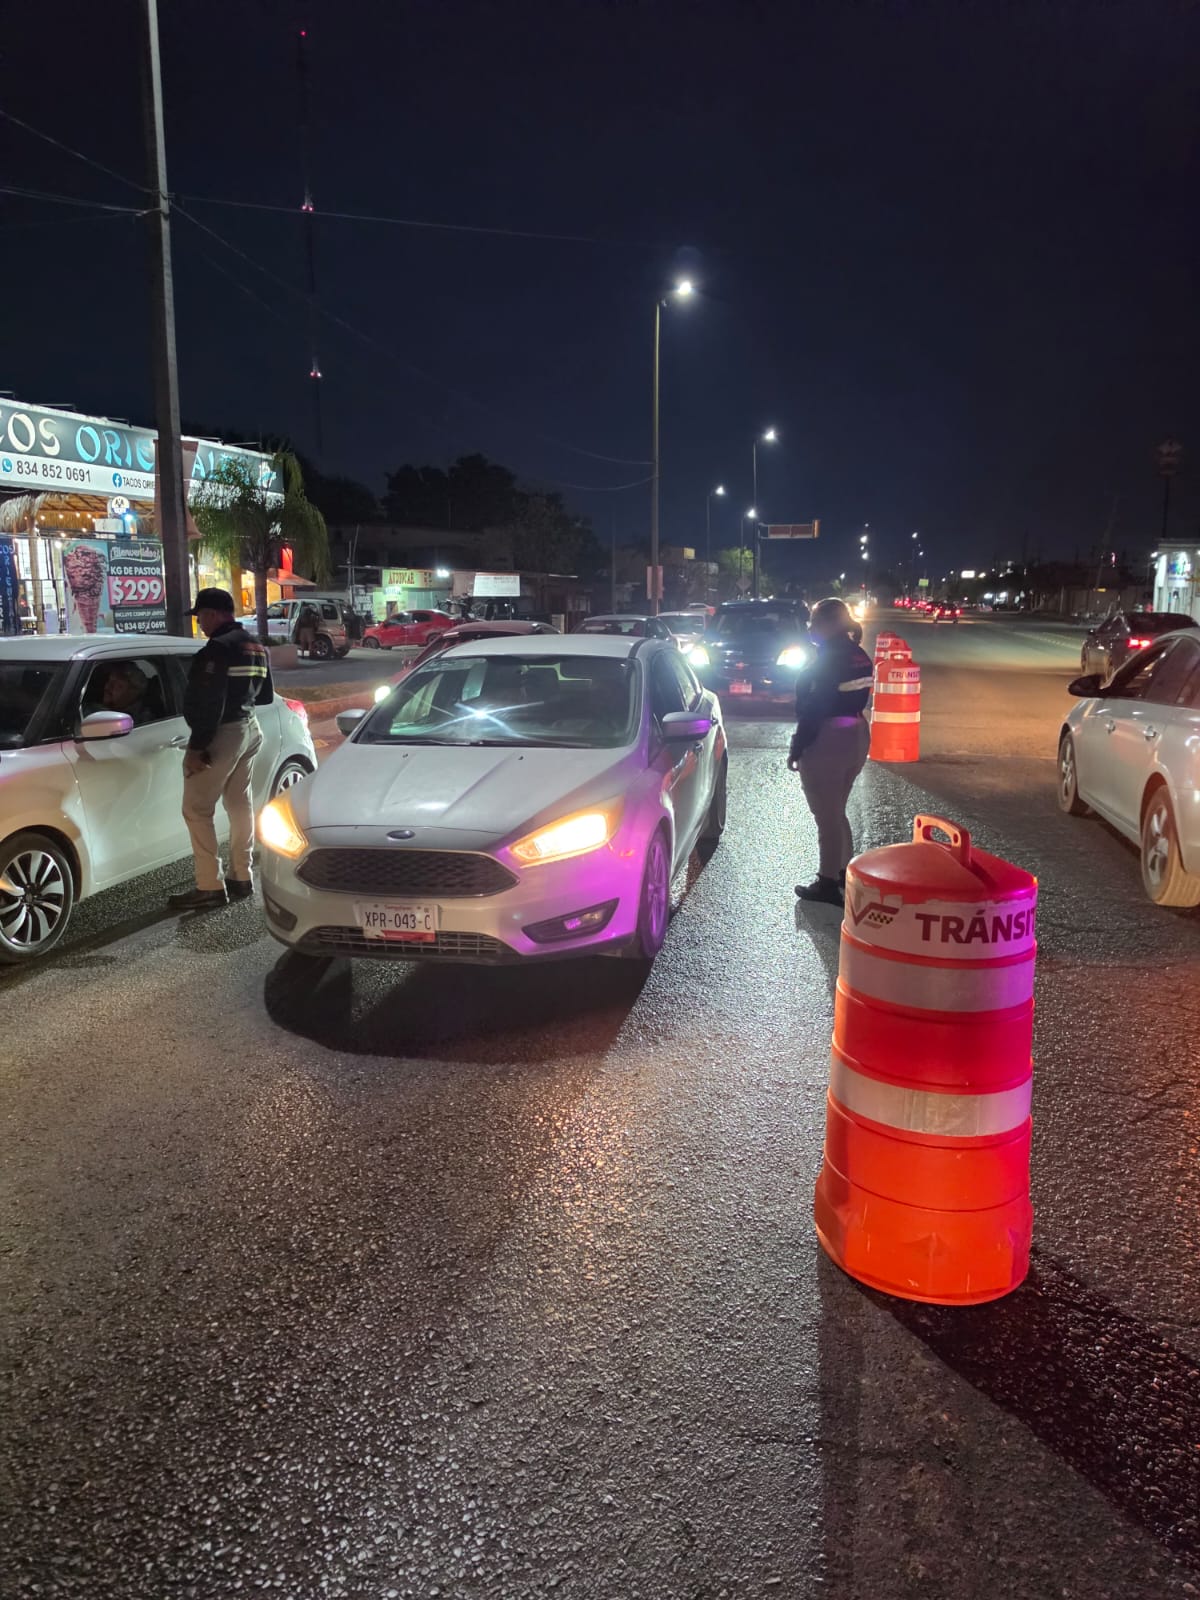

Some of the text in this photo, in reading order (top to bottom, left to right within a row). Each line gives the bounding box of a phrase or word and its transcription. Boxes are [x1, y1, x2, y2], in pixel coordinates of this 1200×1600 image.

[0, 409, 60, 457] OS
[17, 460, 91, 482] 834 852 0691
[123, 477, 142, 489] TACOS
[110, 566, 161, 576] KG DE PASTOR
[112, 577, 162, 603] $299
[124, 622, 137, 631] 834
[364, 911, 432, 930] XPR-043-C
